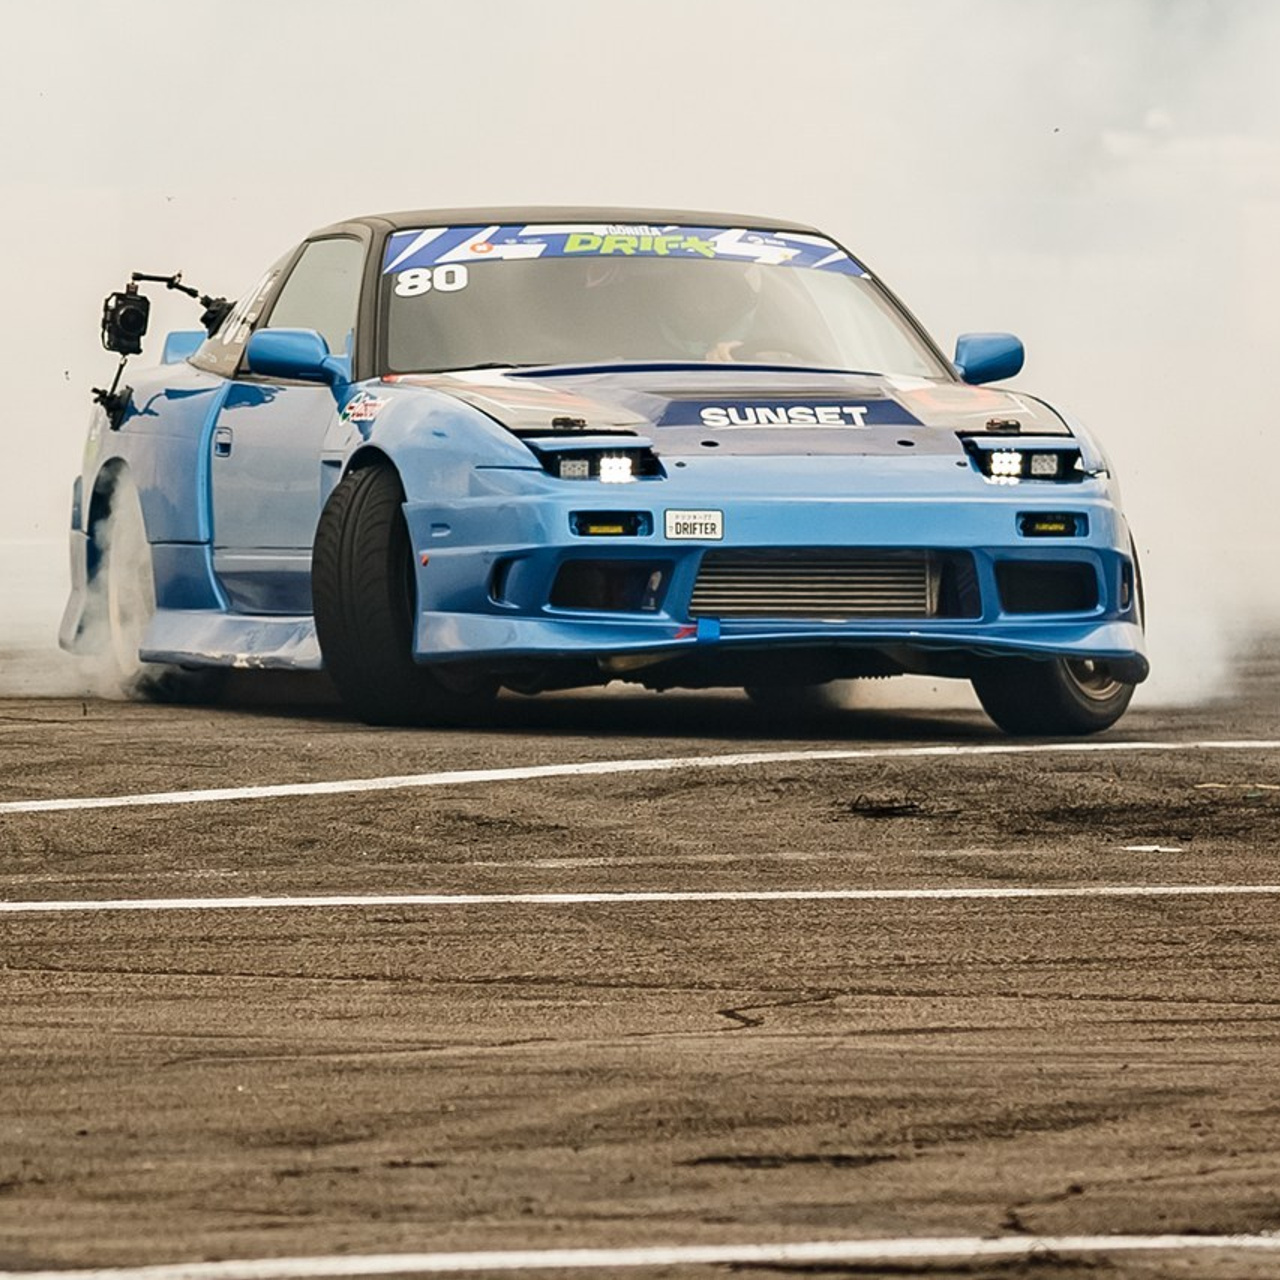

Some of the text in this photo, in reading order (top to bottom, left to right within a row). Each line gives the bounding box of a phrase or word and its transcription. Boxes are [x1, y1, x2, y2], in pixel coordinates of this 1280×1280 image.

[563, 233, 716, 258] DRIFT
[395, 263, 468, 297] 80
[699, 406, 868, 428] SUNSET
[674, 521, 717, 535] DRIFTER
